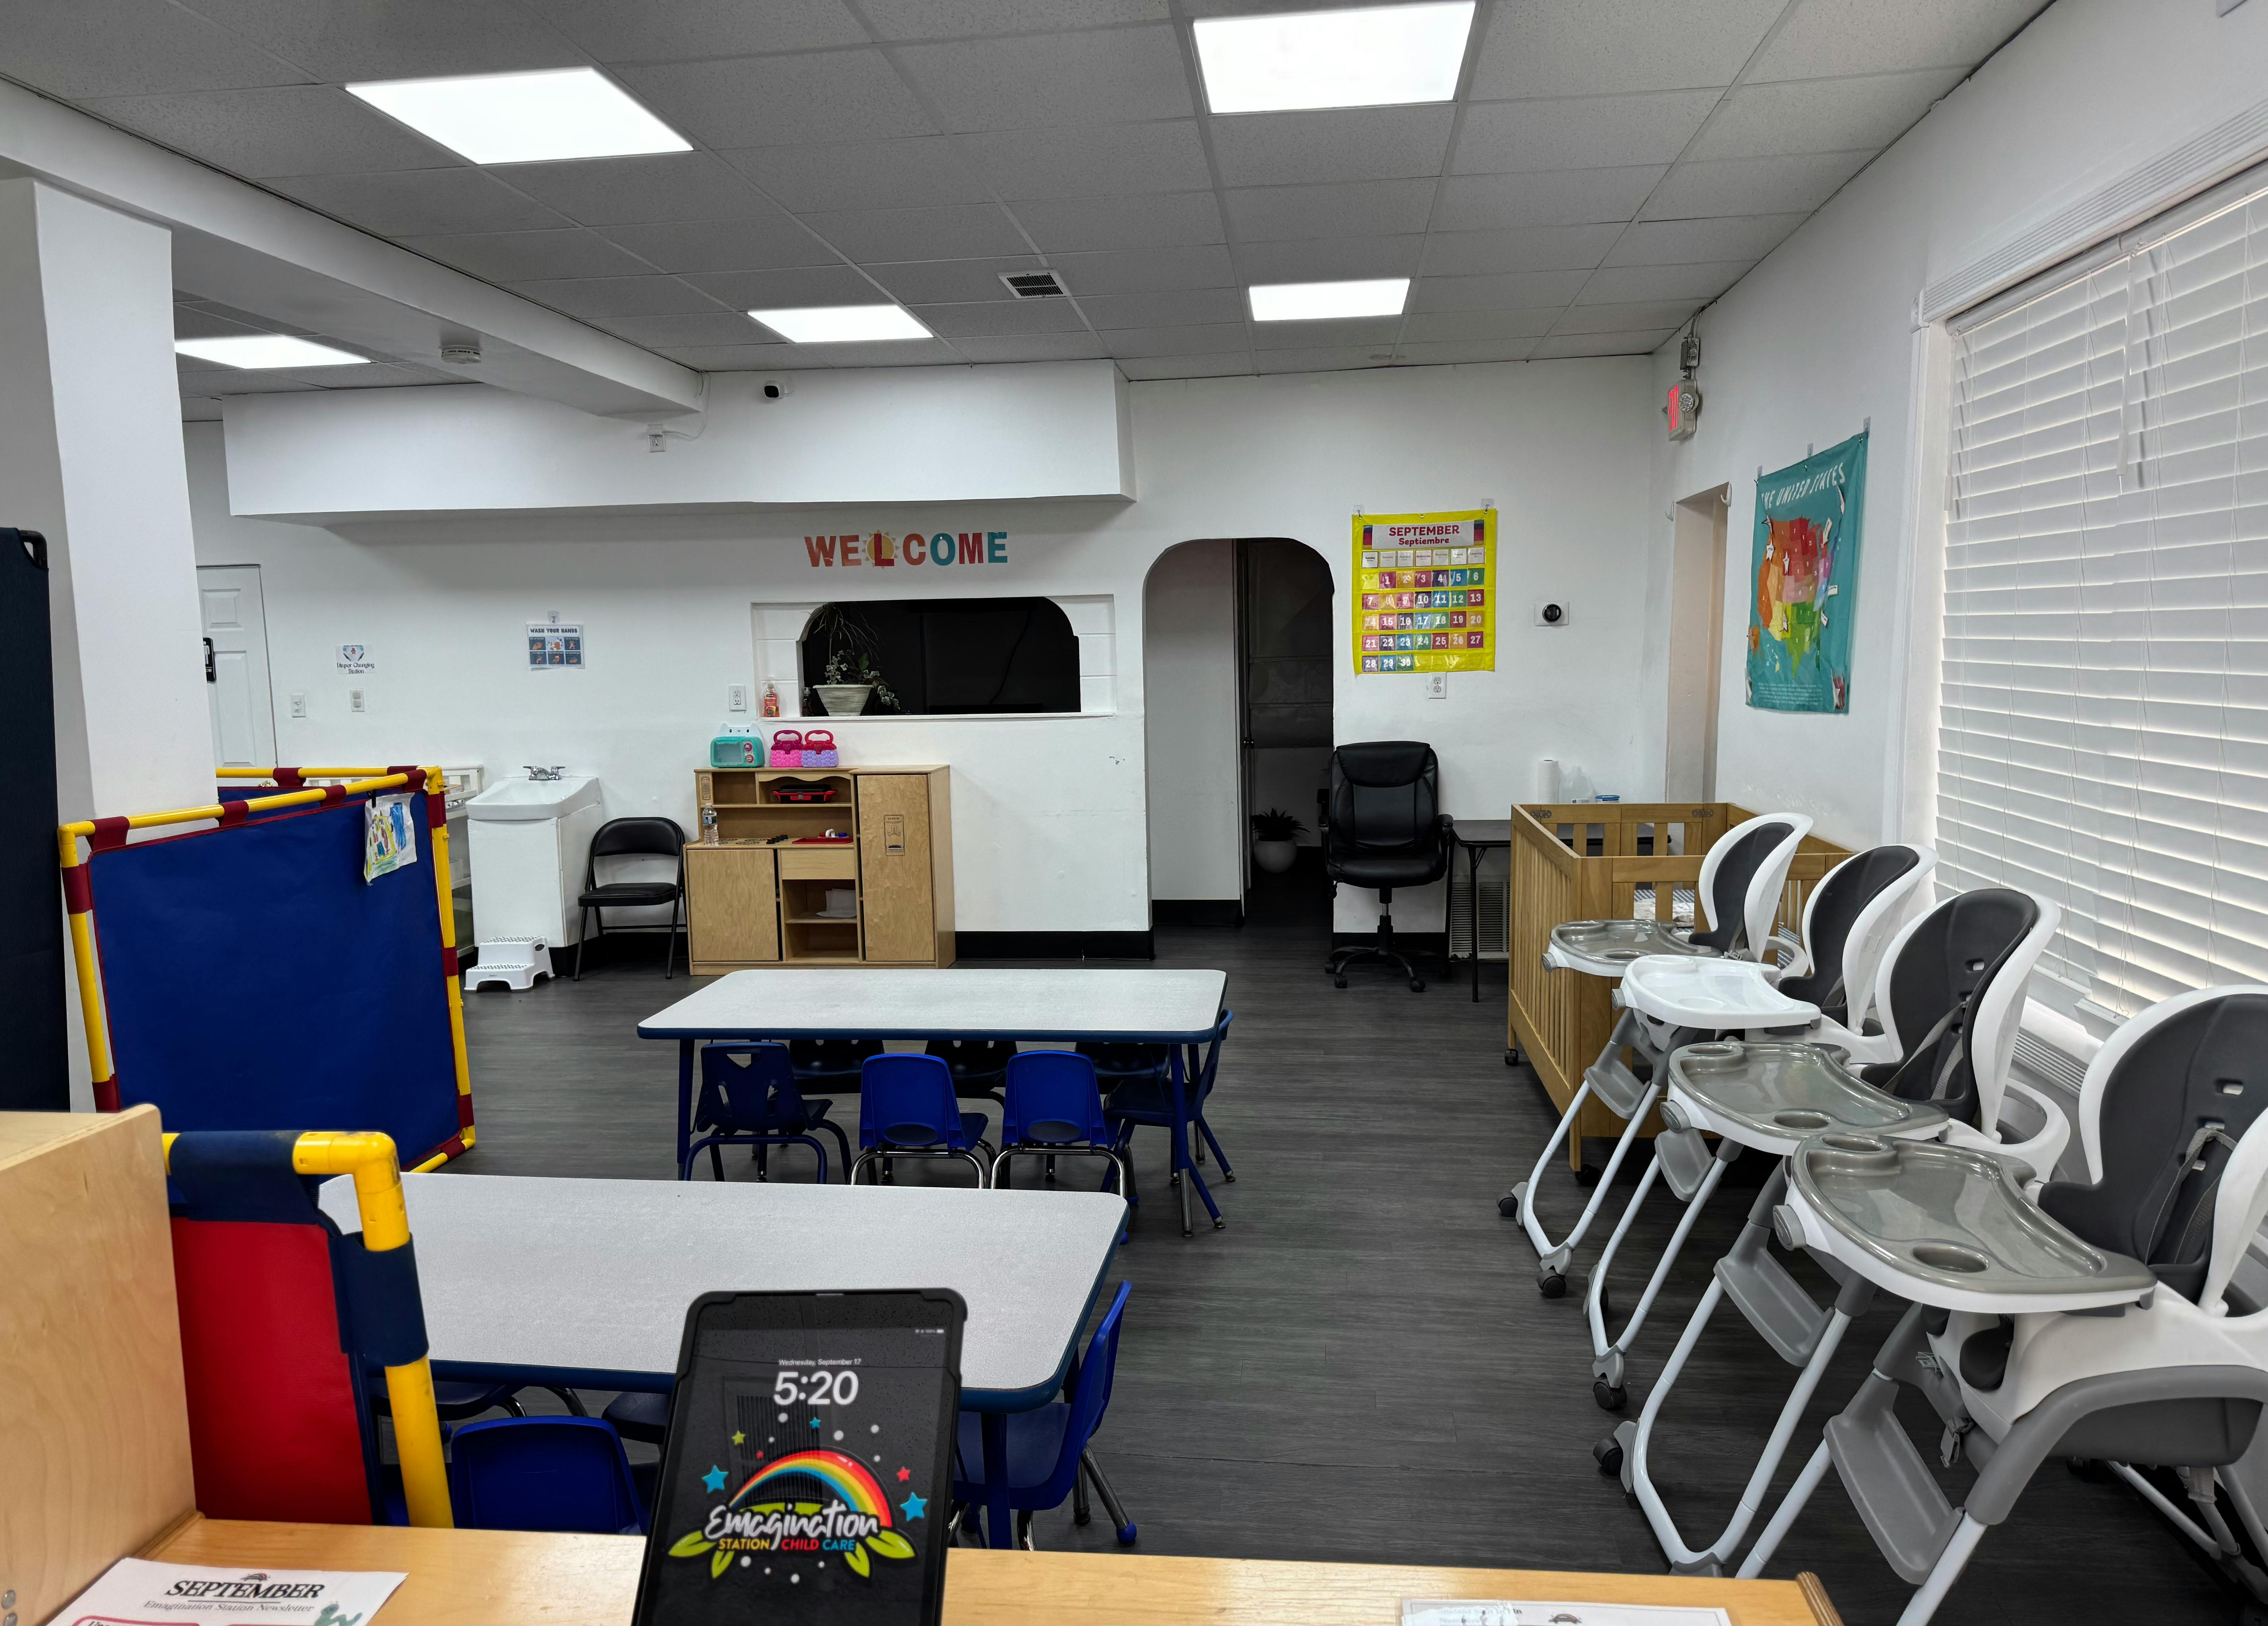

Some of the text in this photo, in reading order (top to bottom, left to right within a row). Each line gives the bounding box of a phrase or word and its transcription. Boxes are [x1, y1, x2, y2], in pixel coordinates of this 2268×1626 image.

[1761, 462, 1845, 510] THE UNITED STATES
[1389, 525, 1460, 536] SEPTEMBER
[1399, 537, 1449, 547] Septiembre
[804, 532, 1008, 567] WELCOME
[1385, 576, 1390, 584] 1
[1403, 575, 1408, 584] 2
[1438, 574, 1443, 582] 4
[1456, 573, 1461, 582] 5
[1473, 572, 1479, 581] 6
[1368, 597, 1373, 605] 7
[1418, 595, 1429, 604] 10
[1435, 595, 1447, 603] 11
[1470, 594, 1481, 602] 13
[1382, 617, 1393, 626] 15
[1418, 617, 1429, 625] 17
[1453, 615, 1463, 624] 19
[1471, 615, 1481, 624] 20
[1365, 640, 1376, 648] 21
[1382, 638, 1393, 647] 22
[1418, 636, 1429, 645] 24
[1471, 636, 1481, 644] 27
[1365, 659, 1376, 668] 28
[773, 1371, 859, 1405] 5:20
[705, 1499, 878, 1551] Emagination
[719, 1538, 856, 1550] STATION CHILD CARE
[165, 1580, 325, 1598] SEPTEMBER
[143, 1601, 213, 1612] Emagination
